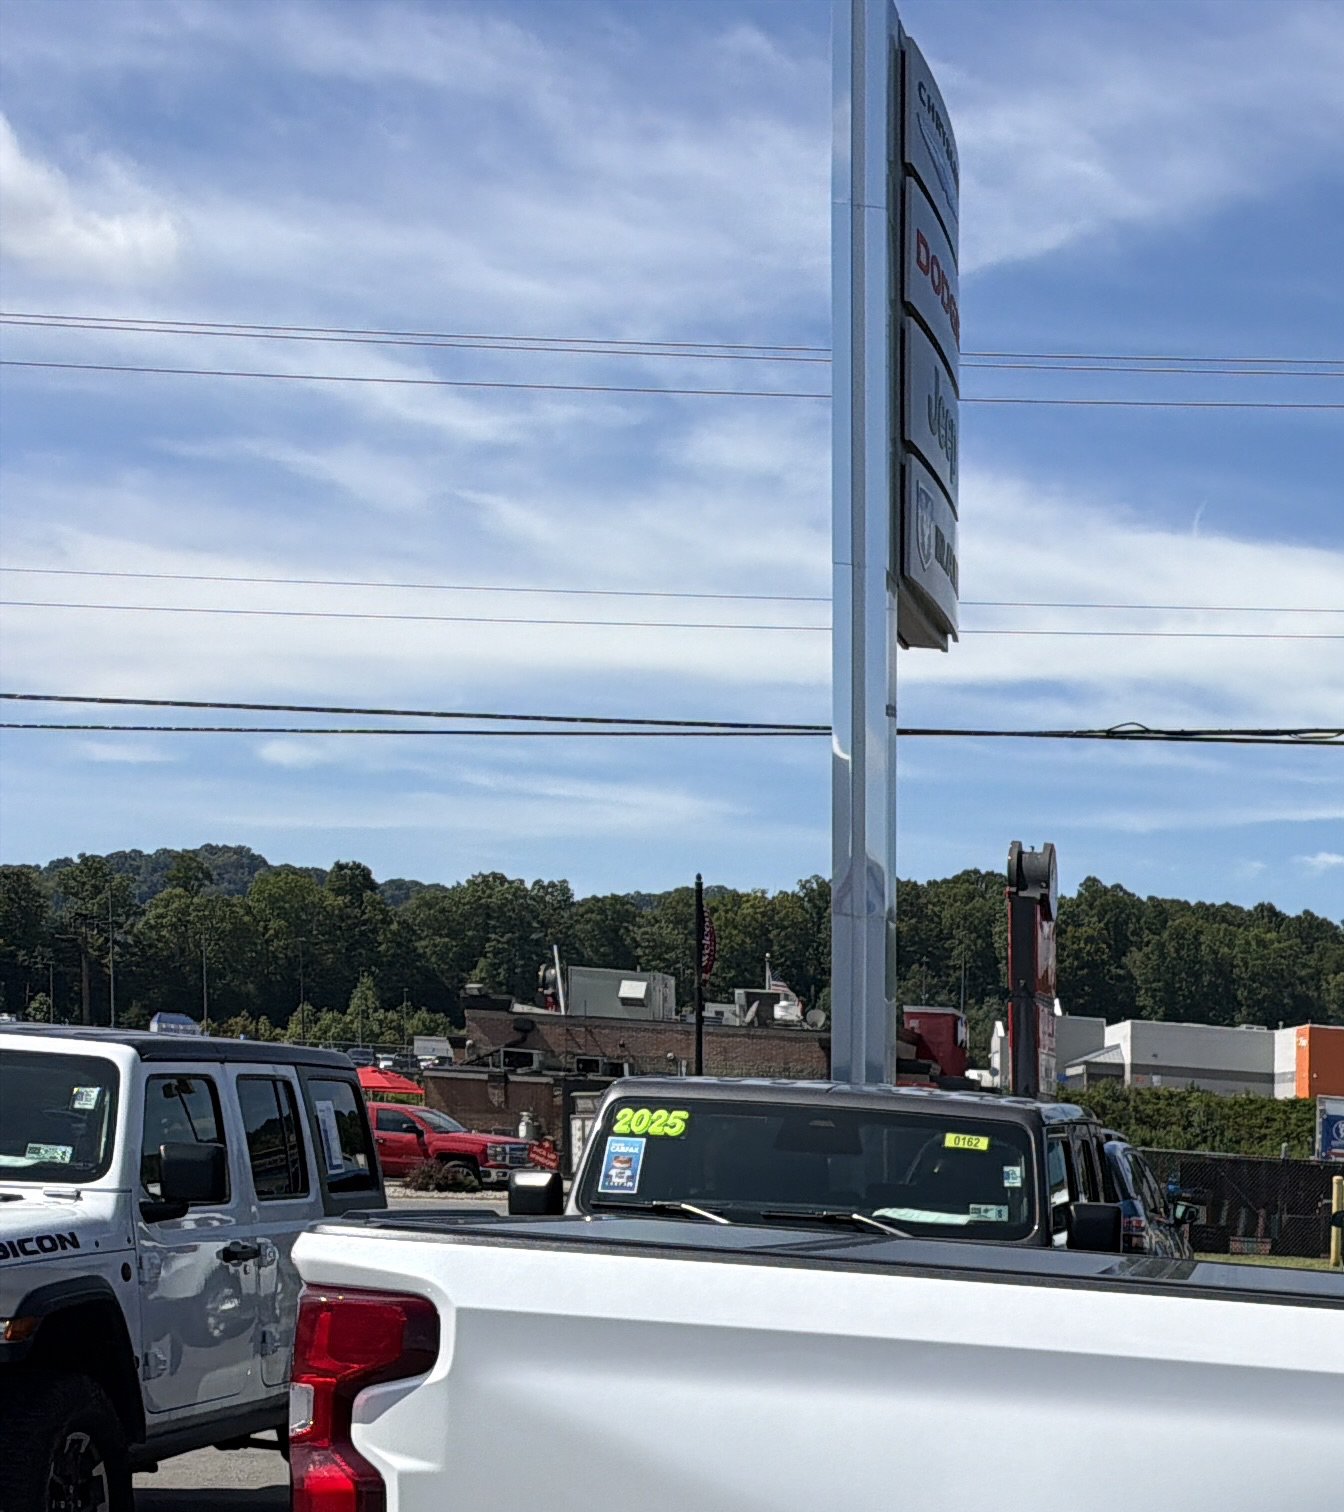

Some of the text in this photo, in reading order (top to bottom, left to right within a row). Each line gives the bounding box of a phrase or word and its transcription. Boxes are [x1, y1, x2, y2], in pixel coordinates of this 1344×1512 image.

[928, 364, 957, 484] Jeep
[613, 1108, 690, 1137] 2025
[953, 1135, 981, 1148] 0162
